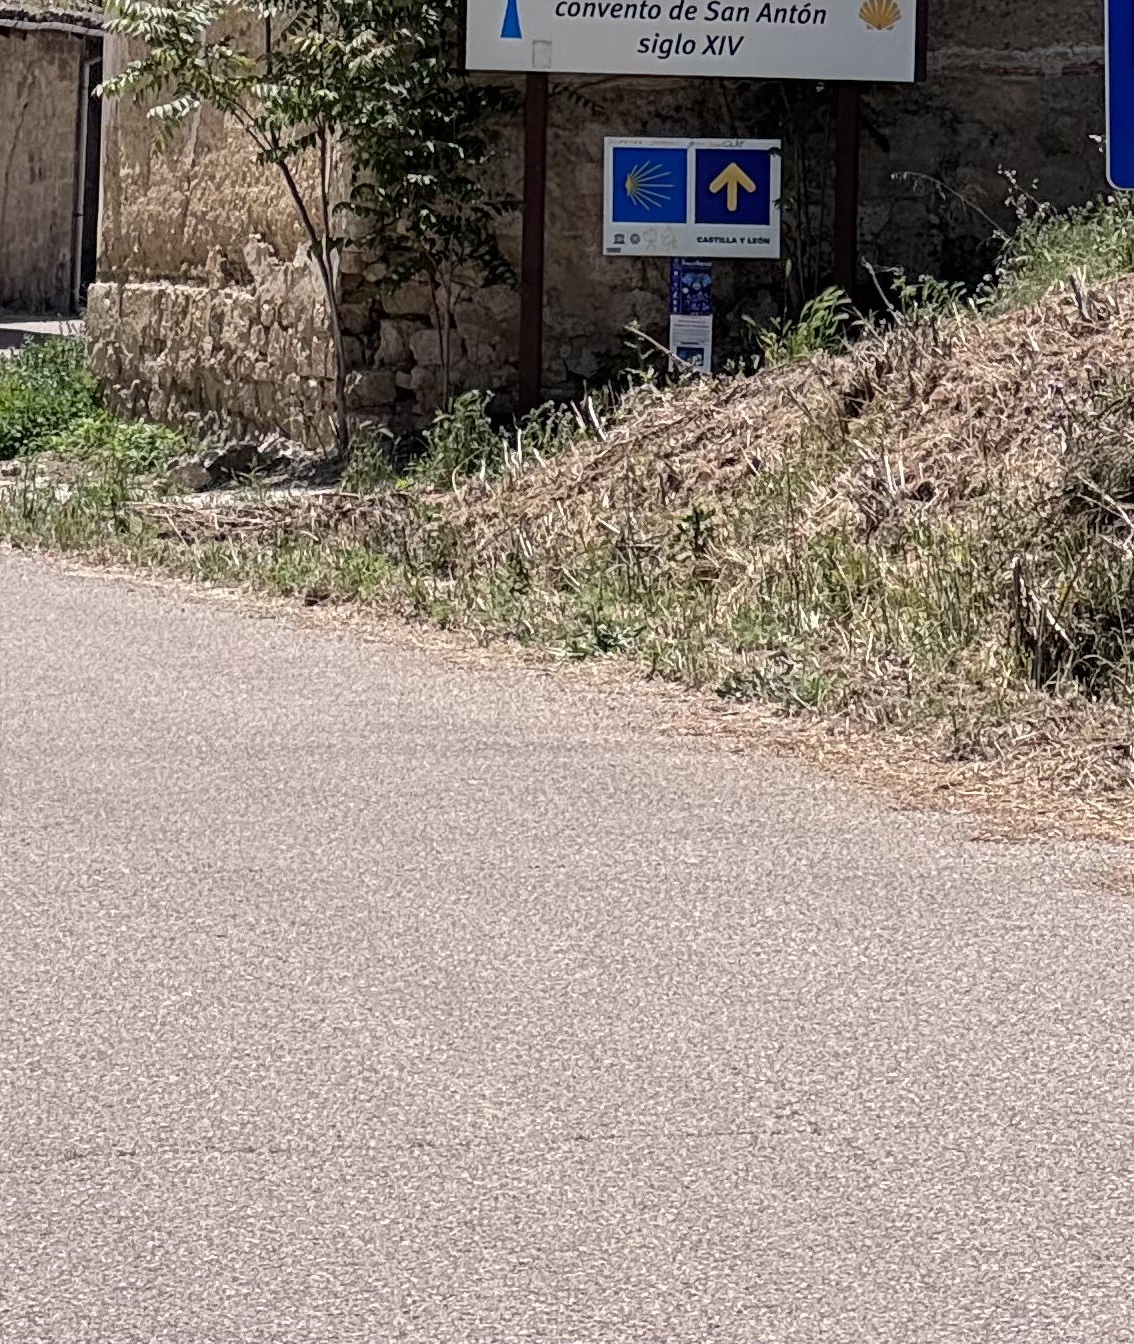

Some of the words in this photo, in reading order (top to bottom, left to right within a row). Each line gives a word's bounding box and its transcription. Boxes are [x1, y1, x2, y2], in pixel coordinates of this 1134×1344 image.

[555, 0, 662, 19] convento
[668, 0, 698, 20] de
[704, 0, 750, 22] San
[756, 3, 827, 25] Antón
[637, 33, 696, 59] siglo
[701, 35, 745, 56] XIV
[696, 236, 737, 244] CASTILLA
[747, 236, 771, 245] LEÓN
